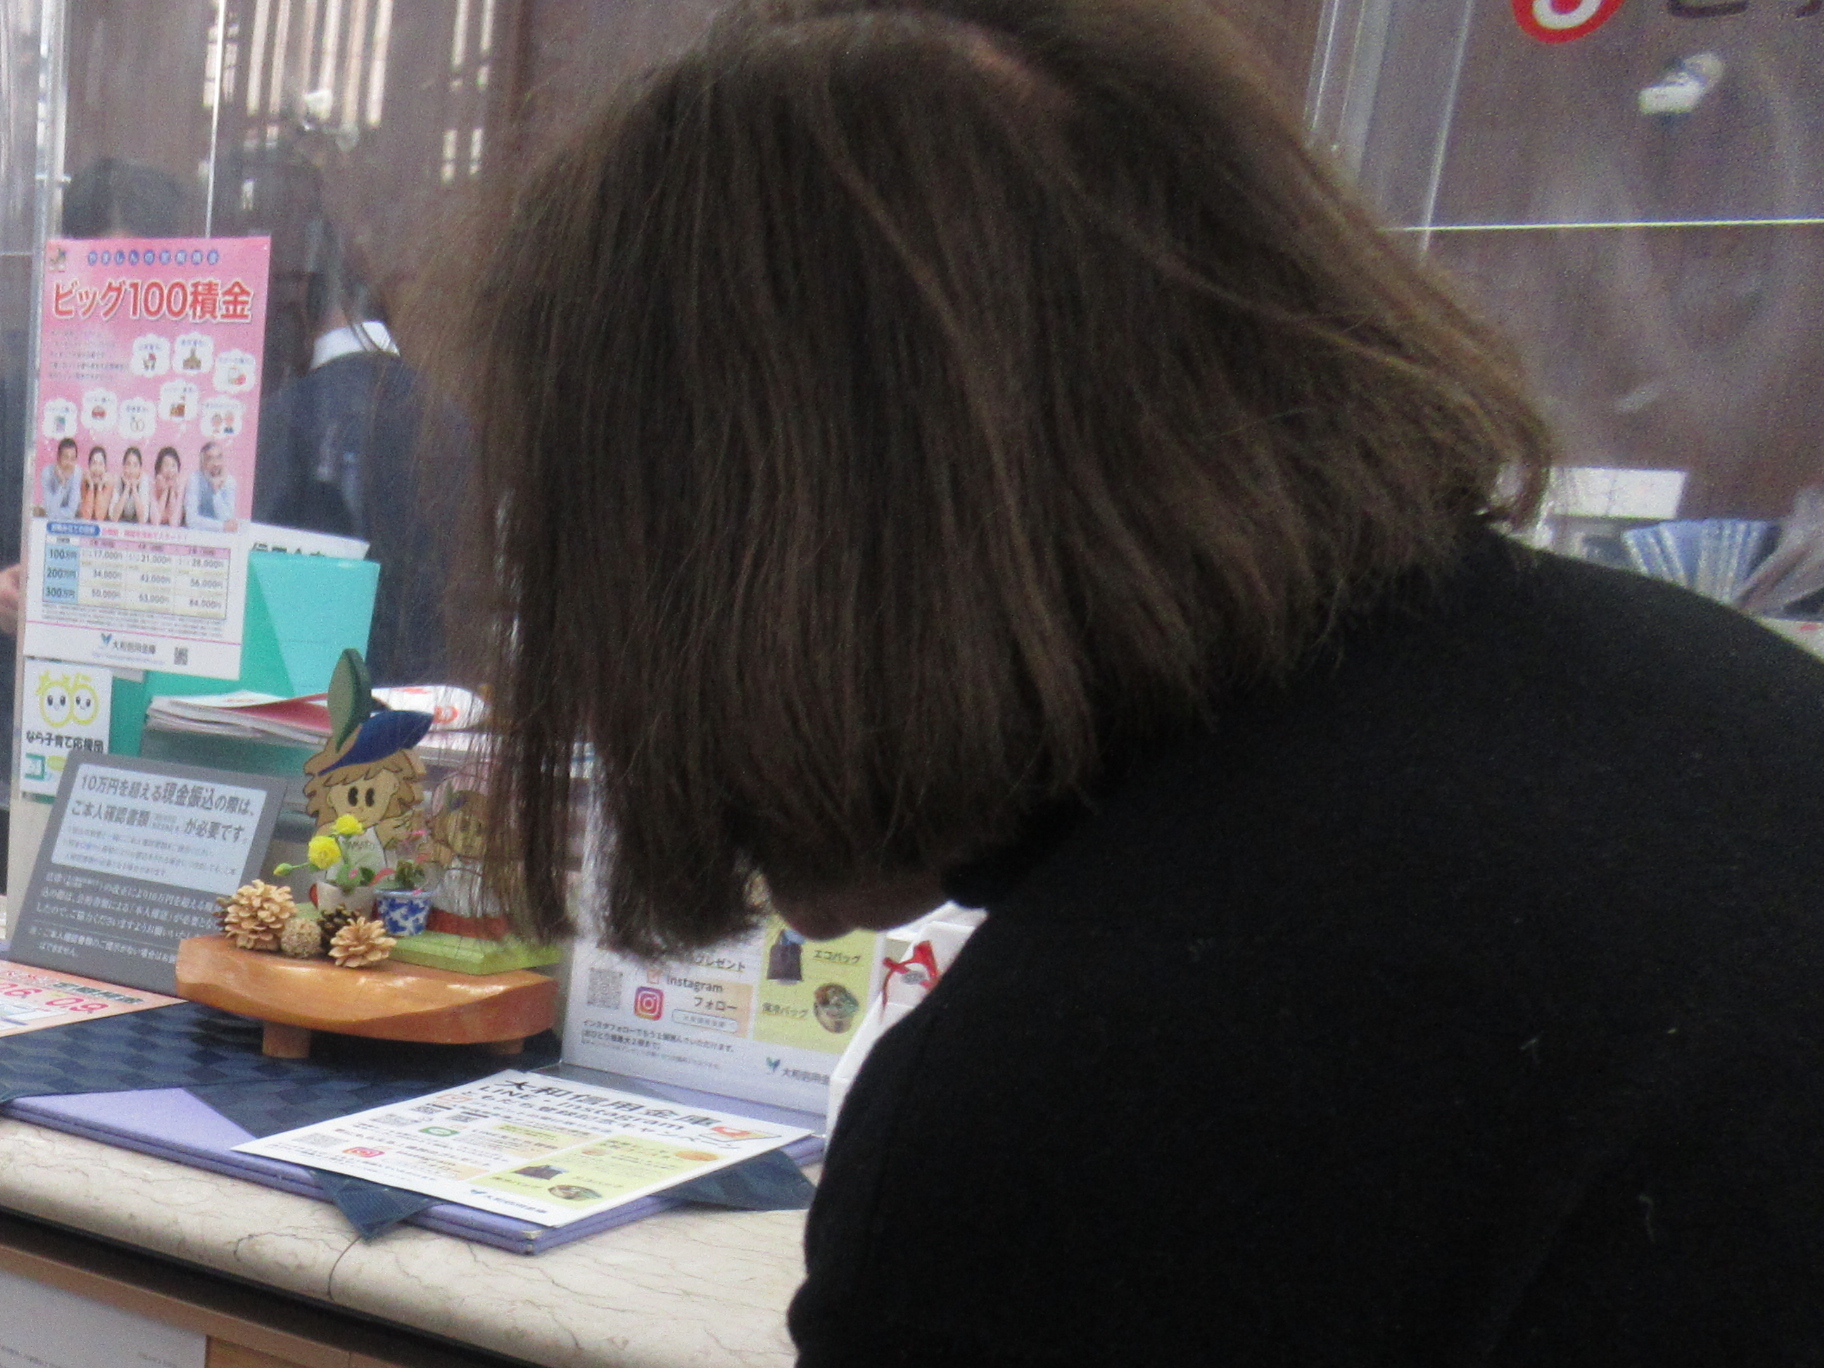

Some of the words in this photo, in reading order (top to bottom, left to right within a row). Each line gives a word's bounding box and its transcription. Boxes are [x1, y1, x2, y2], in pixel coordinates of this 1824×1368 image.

[53, 278, 253, 322] ビッグ100積金
[813, 950, 861, 964] エコバッグ
[666, 973, 724, 995] Instagram
[694, 995, 739, 1011] フォロー
